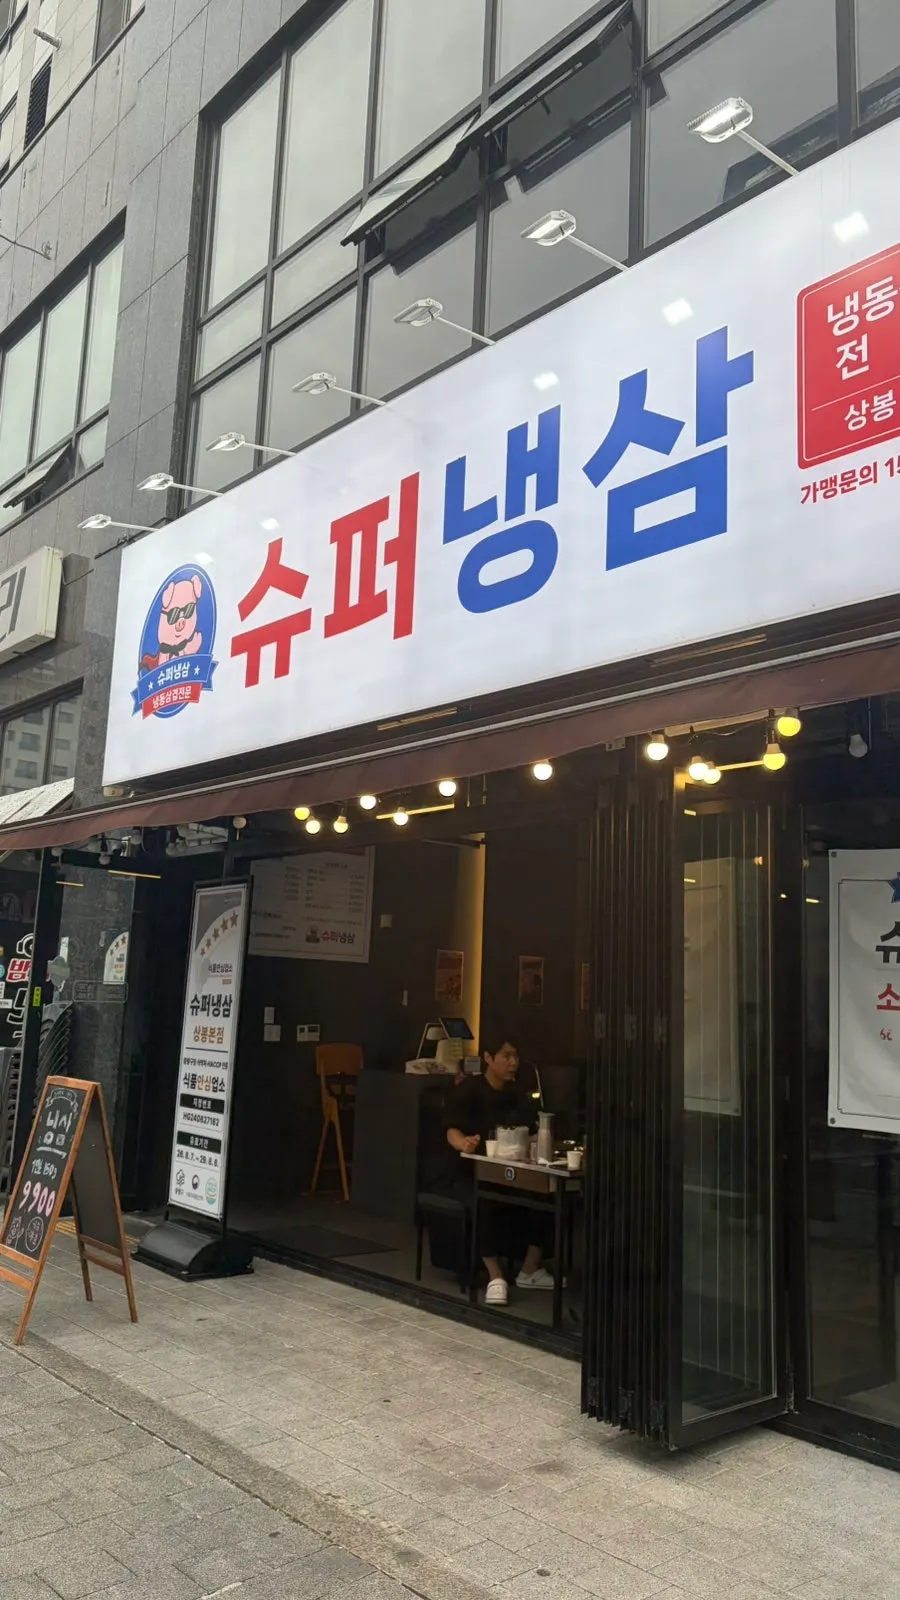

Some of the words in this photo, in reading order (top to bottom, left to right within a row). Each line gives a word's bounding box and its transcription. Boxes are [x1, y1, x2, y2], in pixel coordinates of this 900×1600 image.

[827, 276, 900, 337] 냉동
[836, 333, 869, 380] 전
[844, 389, 896, 431] 상봉
[801, 461, 878, 504] 가맹문의
[231, 326, 754, 689] 슈퍼냉삼
[157, 661, 190, 686] 슈퍼냉삼
[190, 994, 233, 1018] 슈퍼냉삼
[193, 1025, 225, 1044] 상봉본점
[183, 1072, 226, 1093] 식품안심업소
[43, 1110, 73, 1145] 냉삼
